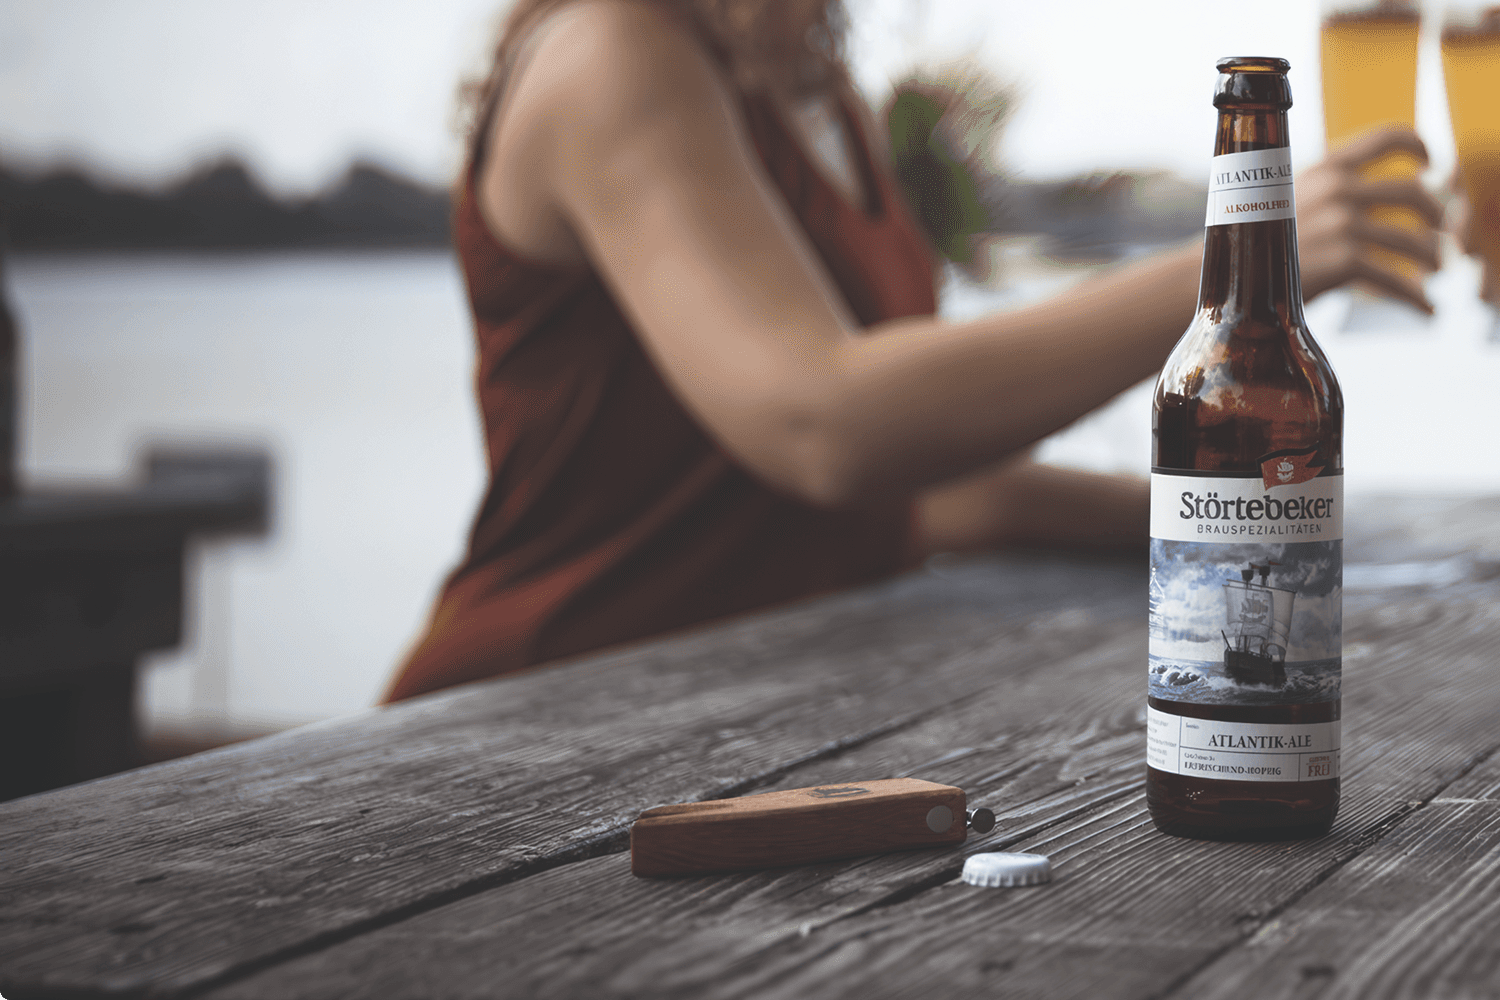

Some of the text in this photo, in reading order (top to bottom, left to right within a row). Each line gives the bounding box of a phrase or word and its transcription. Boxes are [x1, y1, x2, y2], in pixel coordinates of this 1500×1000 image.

[1215, 163, 1292, 185] ATLANTIK-ALE
[1179, 491, 1334, 521] Störtebeker
[1197, 523, 1322, 535] BRAUSPEZIALITÄTEN
[1208, 733, 1312, 749] ATLANTIK-ALE
